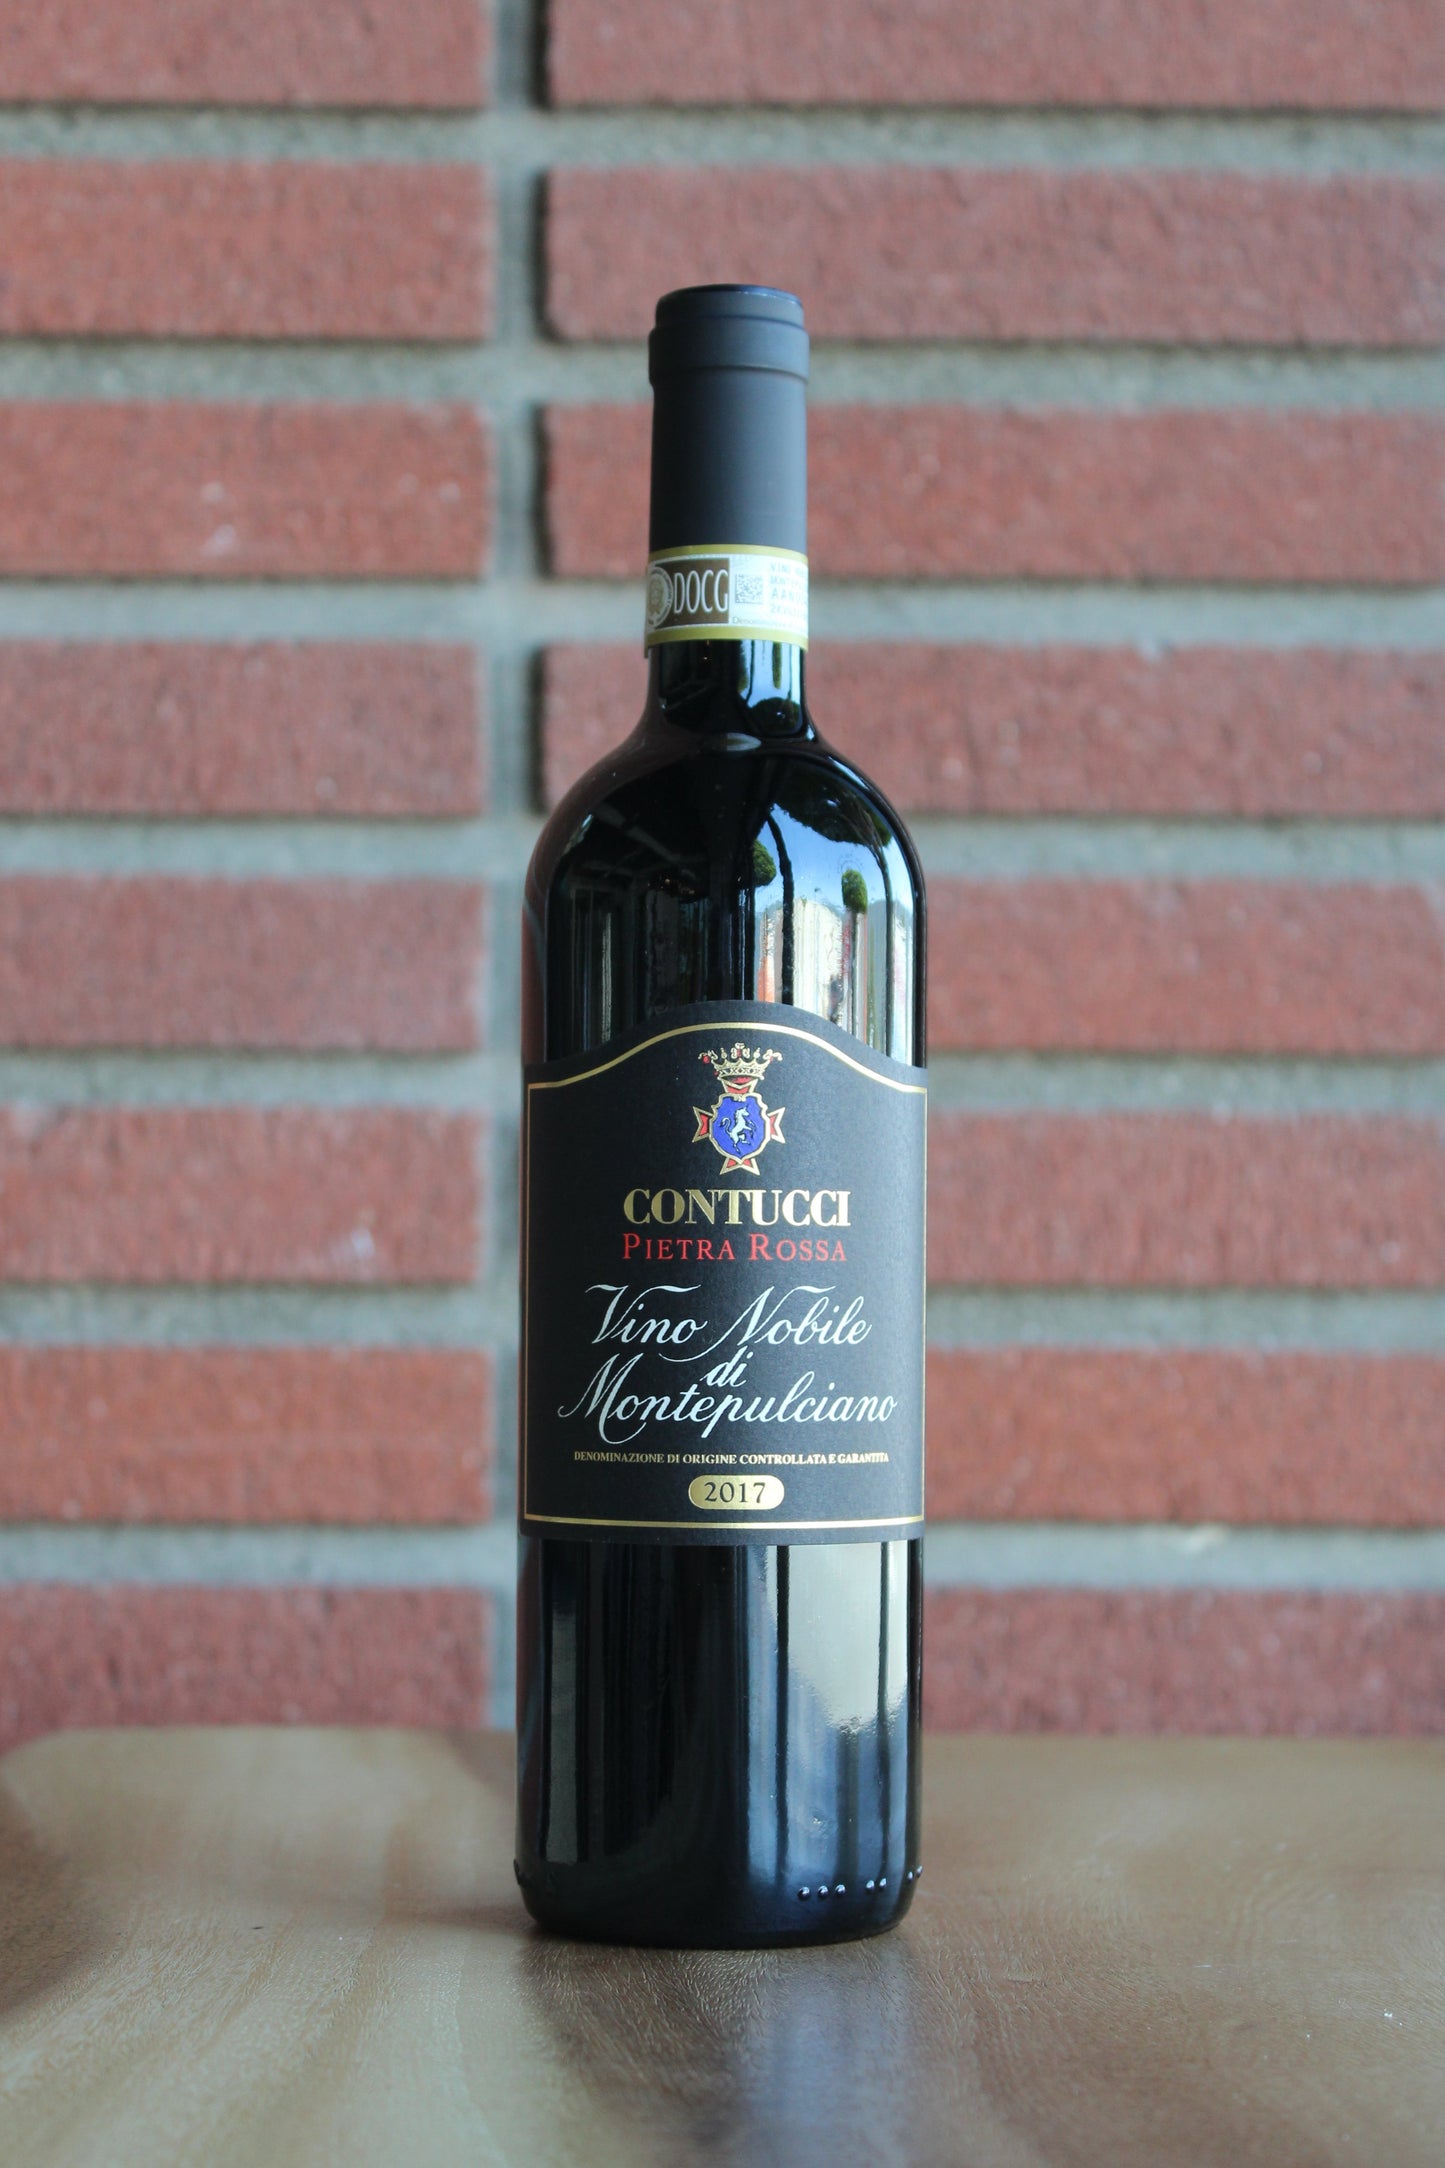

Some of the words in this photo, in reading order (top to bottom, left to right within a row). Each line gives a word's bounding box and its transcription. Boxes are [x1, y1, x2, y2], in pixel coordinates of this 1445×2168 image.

[673, 569, 728, 614] DOCG
[623, 1188, 851, 1227] CONTUCCI
[622, 1233, 735, 1260] PIETRA
[749, 1233, 847, 1262] ROSSA
[585, 1284, 708, 1345] Vino
[659, 1285, 872, 1362] Nobile
[700, 1346, 754, 1388] di
[557, 1352, 898, 1445] Montepulciano
[574, 1451, 664, 1463] DENOMINAZIONE
[667, 1453, 680, 1464] DI
[683, 1453, 737, 1465] ORIGINE
[739, 1454, 828, 1466] CONTROLLATA
[829, 1454, 838, 1465] E
[703, 1482, 766, 1504] 2017
